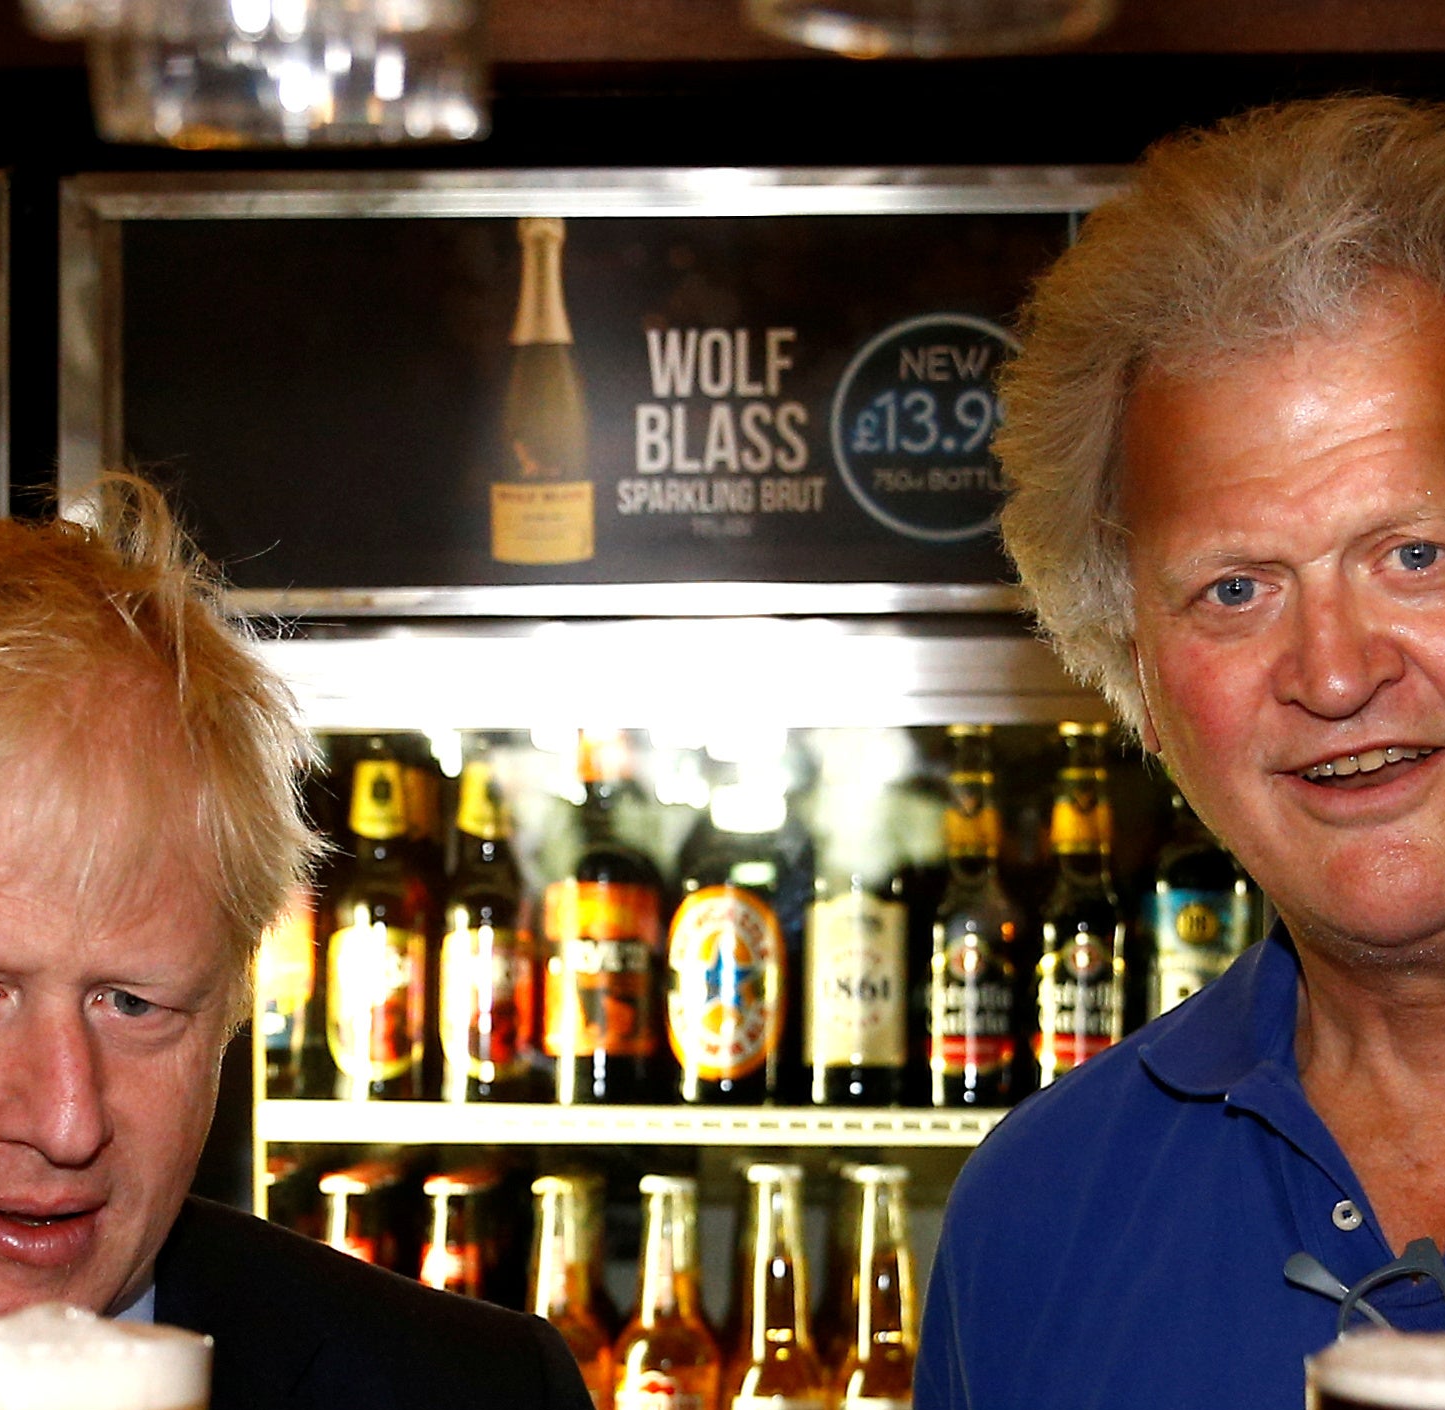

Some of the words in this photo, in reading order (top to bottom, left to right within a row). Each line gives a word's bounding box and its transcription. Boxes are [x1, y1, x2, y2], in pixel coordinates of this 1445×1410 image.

[645, 328, 797, 399] WOLF
[899, 345, 991, 383] NEW
[635, 403, 809, 475] BLASS
[852, 388, 1006, 456] £13.9
[617, 479, 755, 516] SPARKLING
[759, 478, 827, 513] BRUT
[928, 466, 1011, 493] BOTTL
